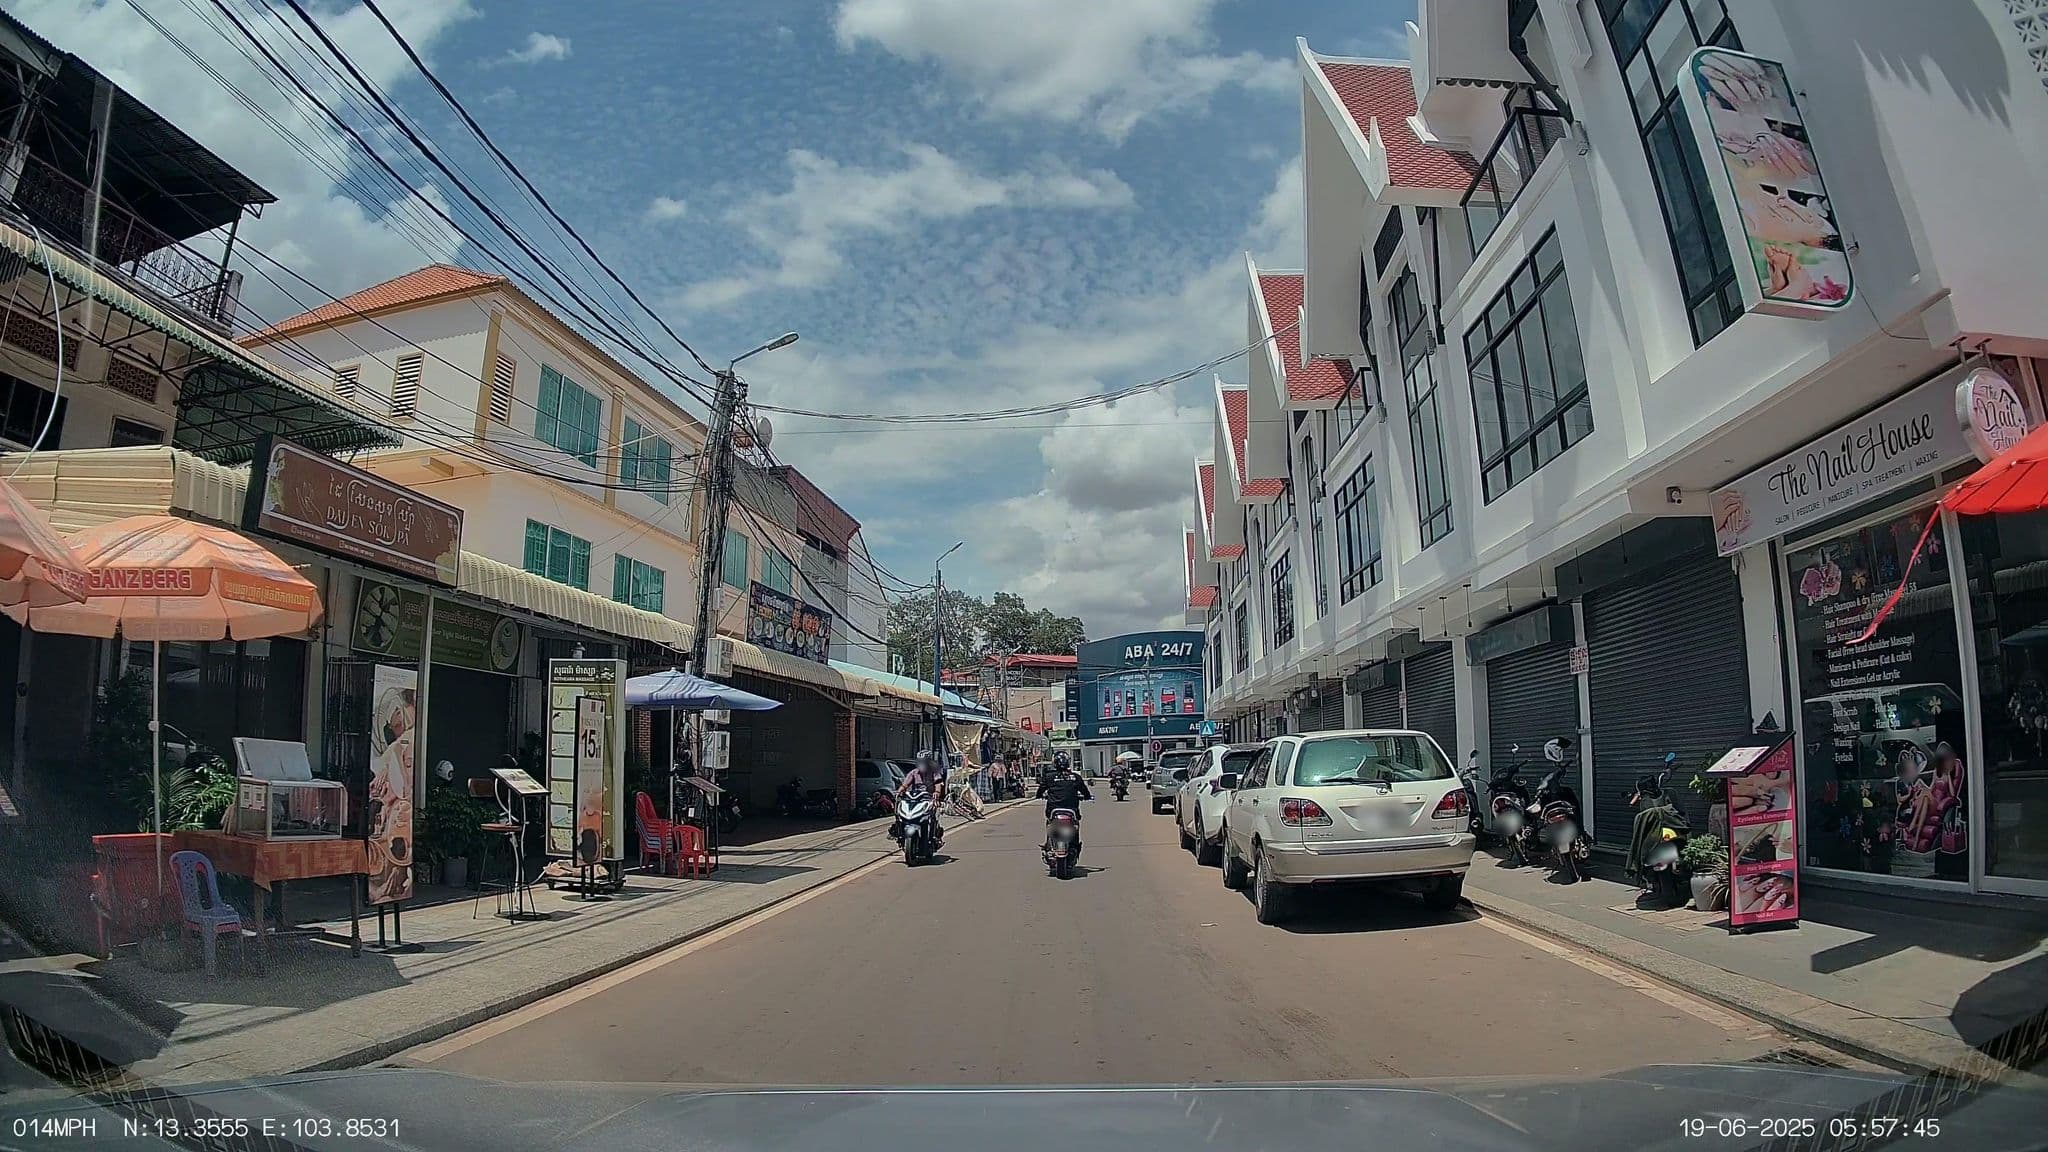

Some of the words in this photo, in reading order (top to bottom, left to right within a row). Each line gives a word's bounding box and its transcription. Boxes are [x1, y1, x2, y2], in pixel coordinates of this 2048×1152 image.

[1980, 384, 1998, 401] The
[1976, 398, 2019, 433] Nail
[1768, 463, 1809, 505] The
[1806, 435, 1858, 491] Nail
[1856, 413, 1934, 474] House
[1861, 479, 1874, 491] SPA
[1875, 464, 1908, 484] TREATMENT
[90, 568, 192, 590] GANZBERG
[1823, 605, 1834, 615] Hair
[1824, 619, 1836, 630] Hair
[1826, 634, 1837, 644] Hair
[1125, 644, 1155, 660] ABA
[1161, 641, 1193, 657] 24/7
[1827, 647, 1842, 659] Facial
[1828, 663, 1851, 674] Manicure
[1856, 658, 1879, 669] Pedicure
[1834, 752, 1854, 765] Eyelash
